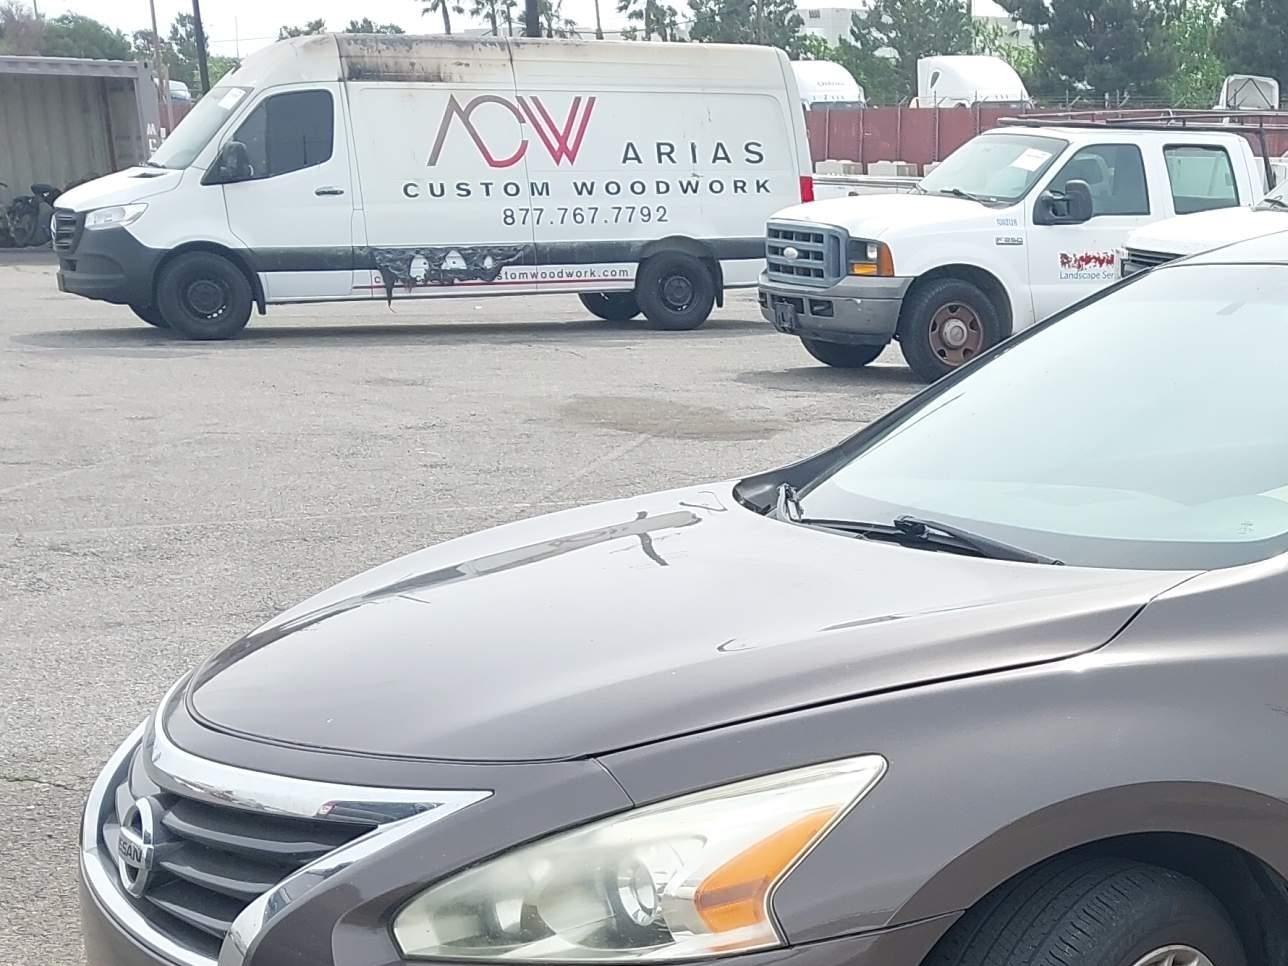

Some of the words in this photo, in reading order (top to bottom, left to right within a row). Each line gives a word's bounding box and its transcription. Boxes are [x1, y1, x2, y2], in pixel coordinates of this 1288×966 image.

[621, 142, 765, 165] ARIAS
[402, 181, 551, 199] CUSTOM
[572, 179, 772, 197] WOODWORK
[502, 205, 669, 226] 877.767.7792
[1059, 271, 1100, 281] Landscape
